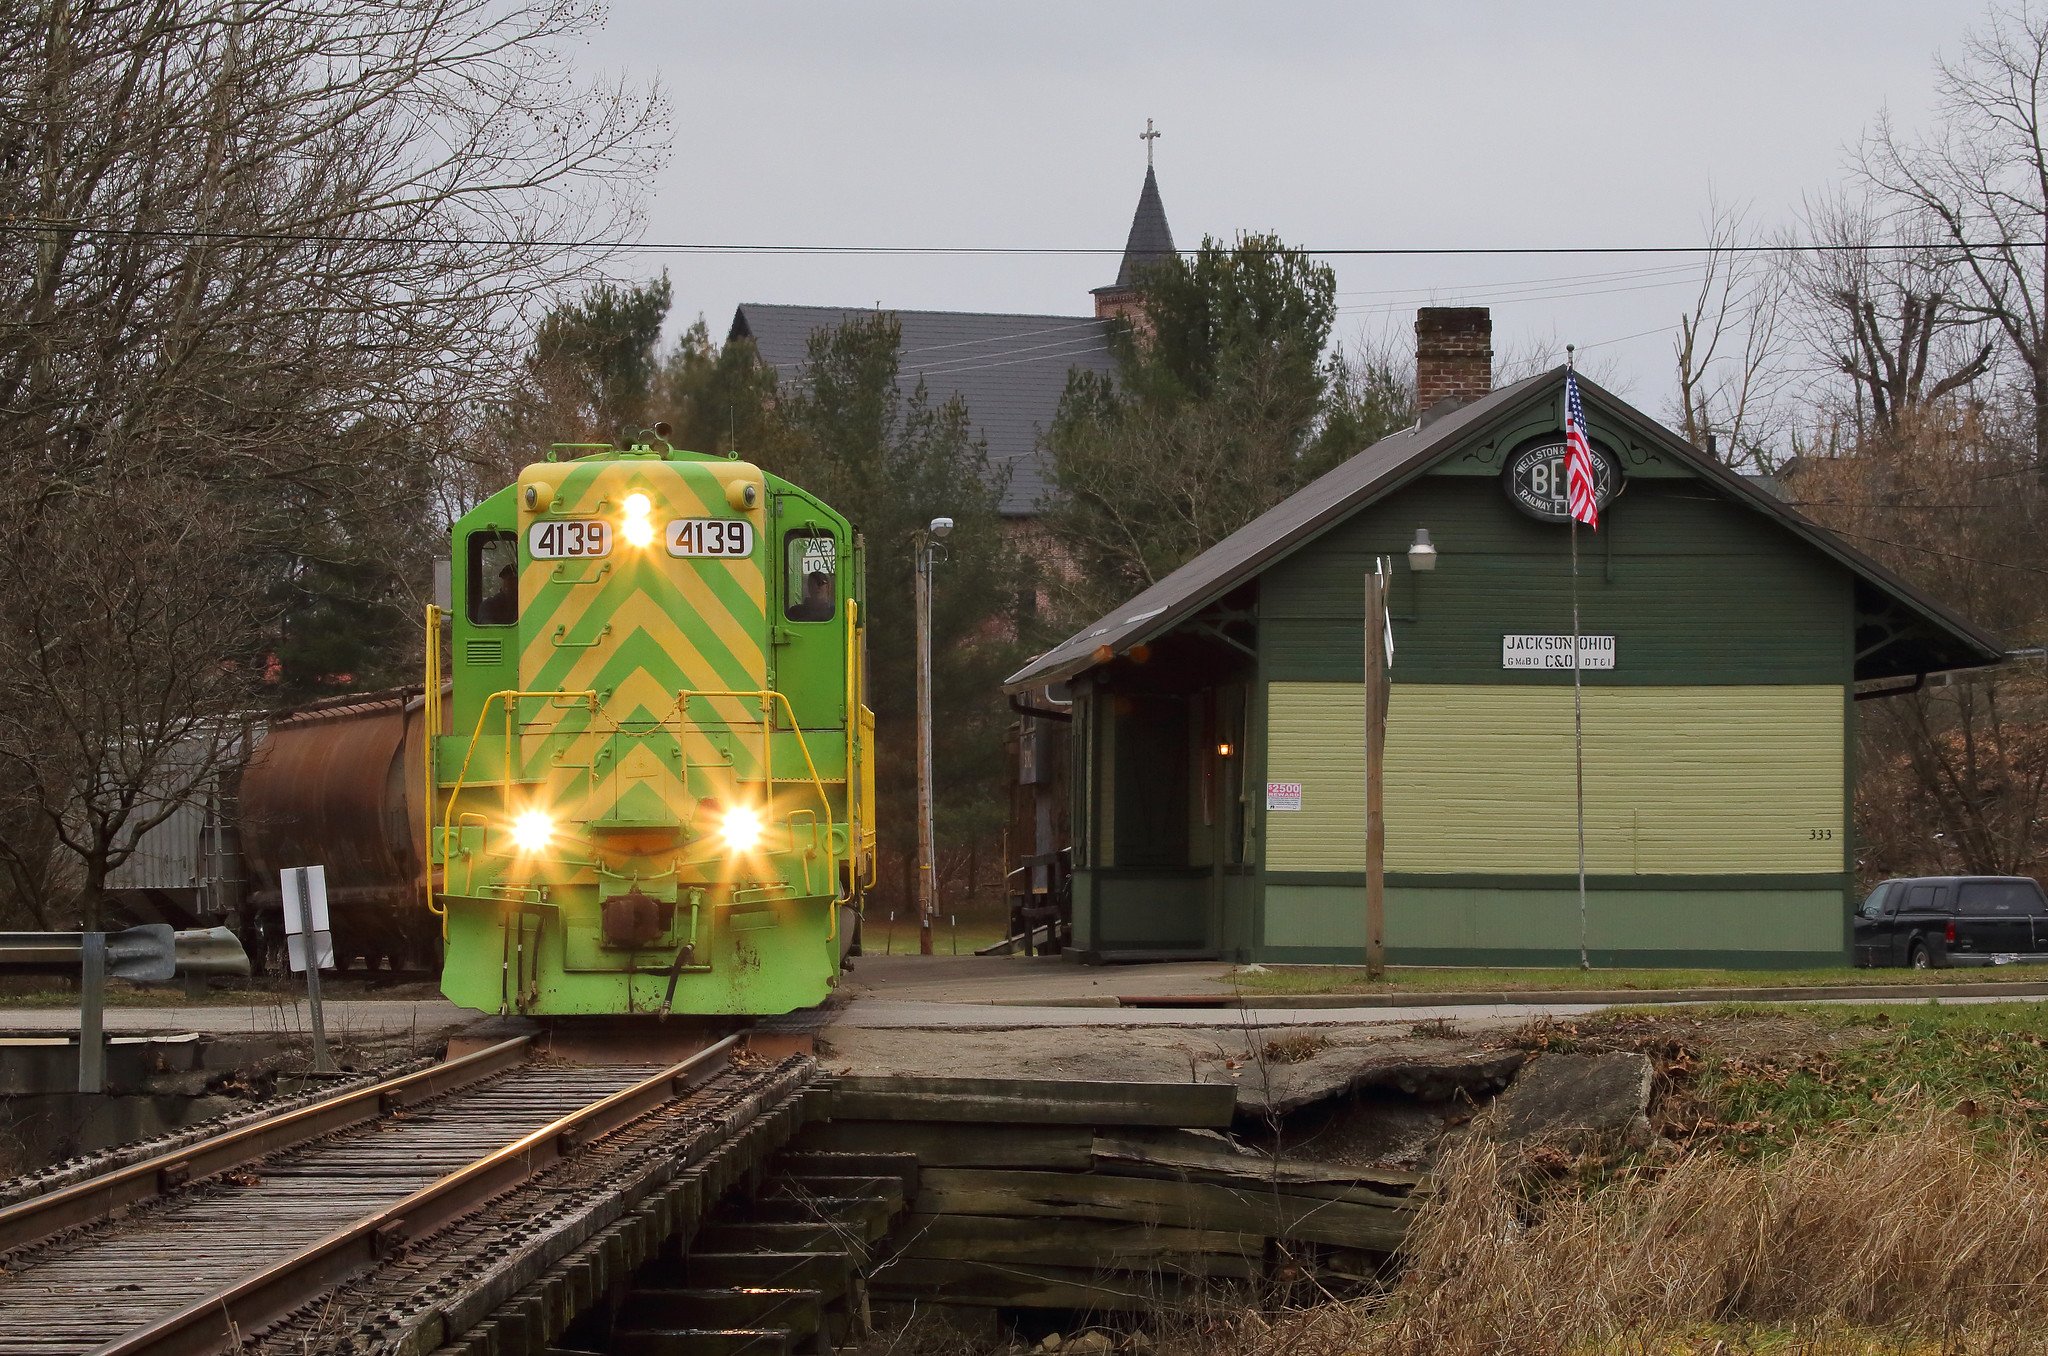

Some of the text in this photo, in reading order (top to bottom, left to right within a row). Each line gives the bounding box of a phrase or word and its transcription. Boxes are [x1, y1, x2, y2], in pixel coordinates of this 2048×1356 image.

[1516, 446, 1566, 474] WELLSTON &
[1532, 458, 1571, 500] BE
[1519, 488, 1552, 511] RAILWAY
[538, 522, 604, 556] 4139
[675, 521, 745, 554] 4139
[1506, 636, 1612, 650] JACKSON OHIO
[1545, 654, 1573, 668] C&O
[1808, 829, 1832, 841] 333
